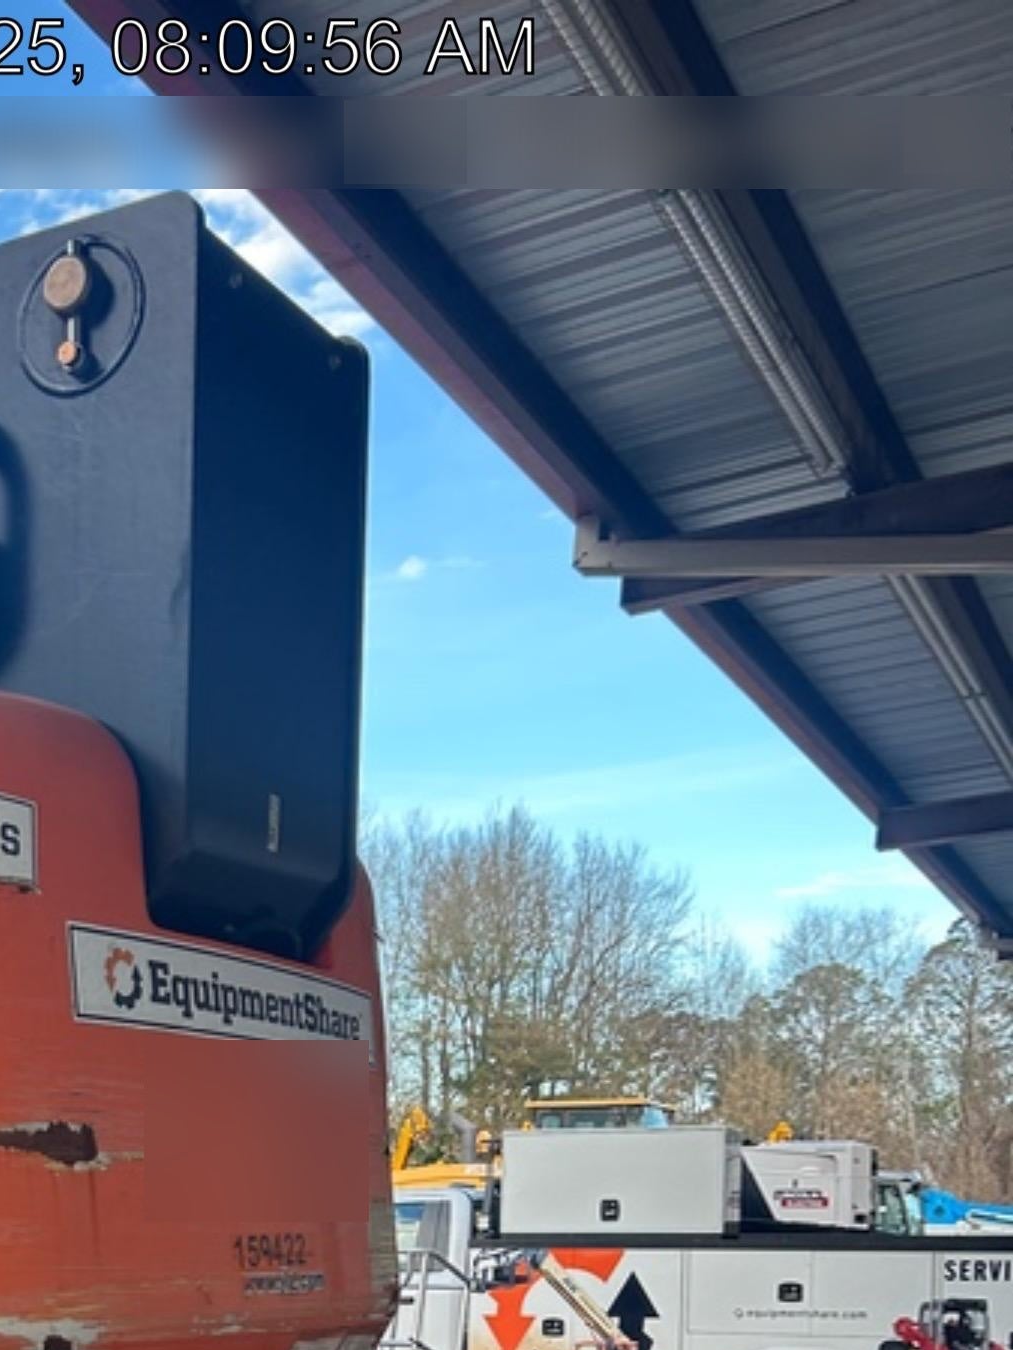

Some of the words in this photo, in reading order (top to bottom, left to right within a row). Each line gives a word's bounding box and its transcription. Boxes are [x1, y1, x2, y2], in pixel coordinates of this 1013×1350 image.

[147, 958, 361, 1041] EquipmentShare
[233, 1232, 308, 1268] 159422
[944, 1259, 1012, 1281] SERVI
